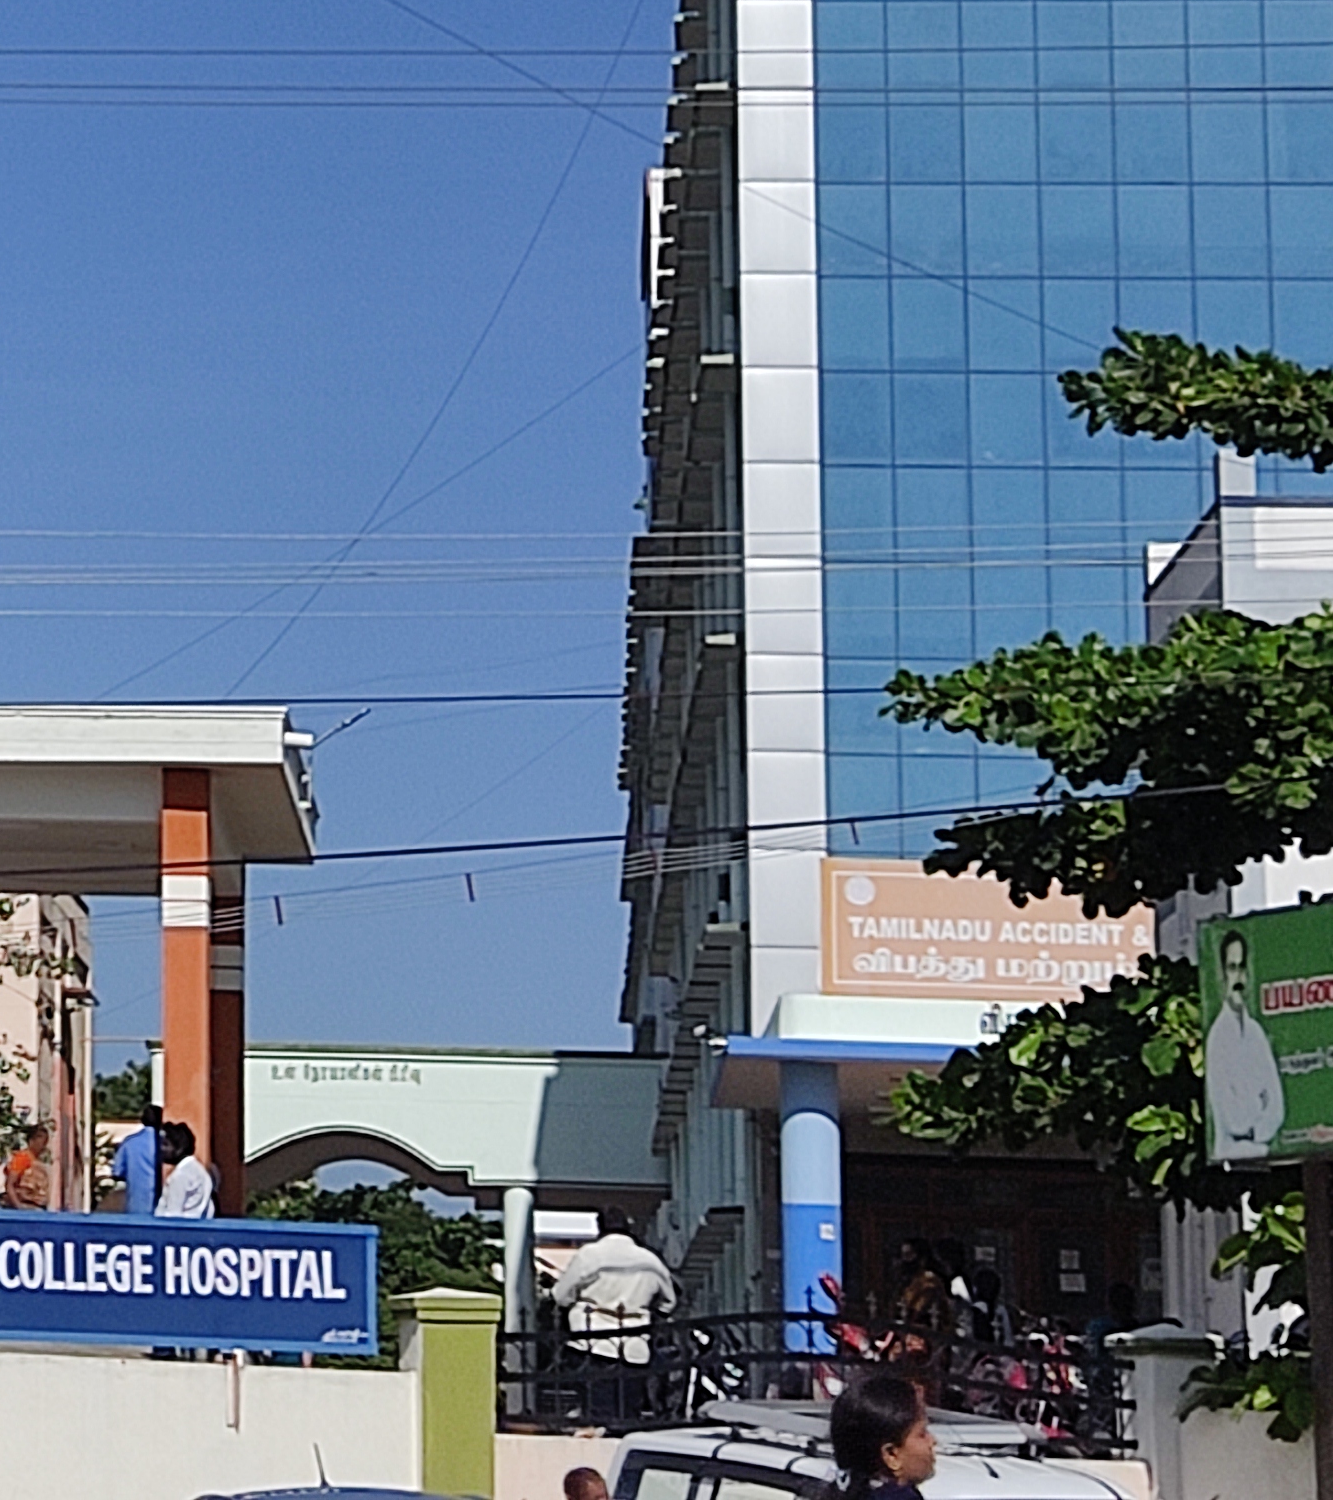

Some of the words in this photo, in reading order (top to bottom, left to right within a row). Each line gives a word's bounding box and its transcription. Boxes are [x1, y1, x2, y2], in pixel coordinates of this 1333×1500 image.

[848, 916, 992, 943] TAMILNADU
[998, 920, 1124, 946] ACCIDENT
[1131, 924, 1150, 947] &
[852, 946, 986, 982] விபத்து
[995, 950, 1141, 986] மற்றும்
[164, 1245, 347, 1300] HOSPITAL
